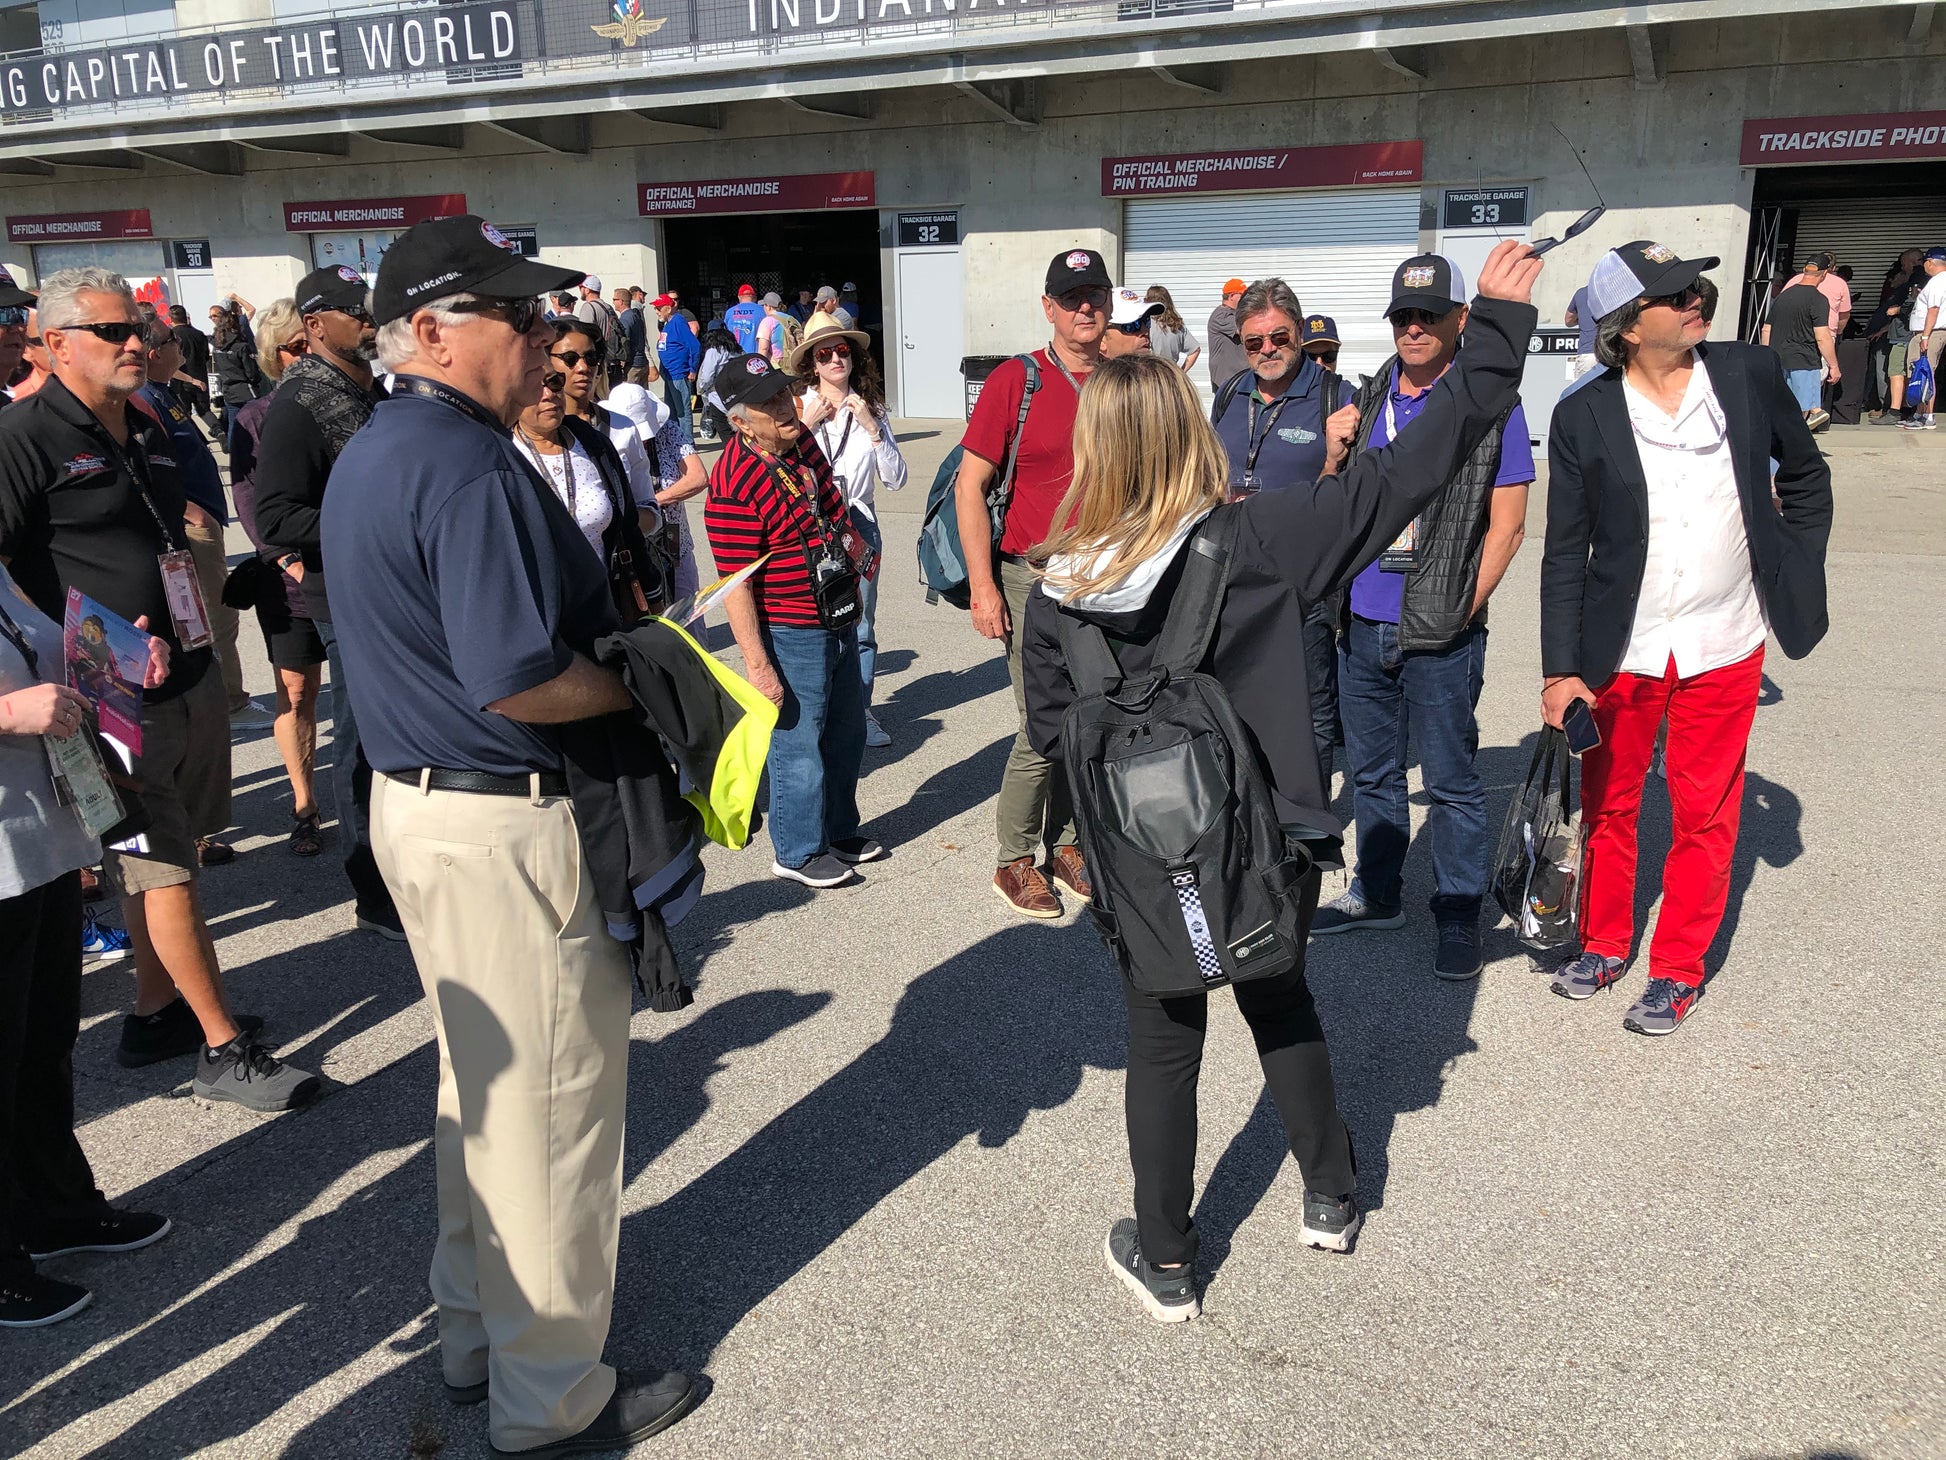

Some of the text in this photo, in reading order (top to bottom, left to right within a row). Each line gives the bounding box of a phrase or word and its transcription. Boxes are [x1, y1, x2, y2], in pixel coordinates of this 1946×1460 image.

[41, 19, 64, 42] 529
[0, 10, 515, 108] G CAPITAL OF THE WORLD
[1759, 128, 1887, 152] TRACKSIDE
[1112, 160, 1171, 177] OFFICIAL
[1174, 155, 1276, 174] MERCHANDISE
[646, 181, 780, 200] OFFICIAL MERCHANDISE
[1112, 174, 1198, 190] PIN TRADING
[1448, 191, 1525, 202] TRACKSDE GARAGE
[291, 207, 405, 224] OFFICIAL MERCHANDISE
[901, 216, 932, 224] TRACKSIDE
[1470, 204, 1500, 224] 33
[12, 220, 102, 236] OFFICIAL MERCHANDISE
[918, 225, 940, 242] 32
[187, 253, 202, 267] 30
[406, 287, 419, 296] ON
[968, 384, 984, 394] KEE
[418, 385, 474, 415] ON LOCATION
[776, 467, 801, 498] MECUM
[832, 602, 855, 618] AARP
